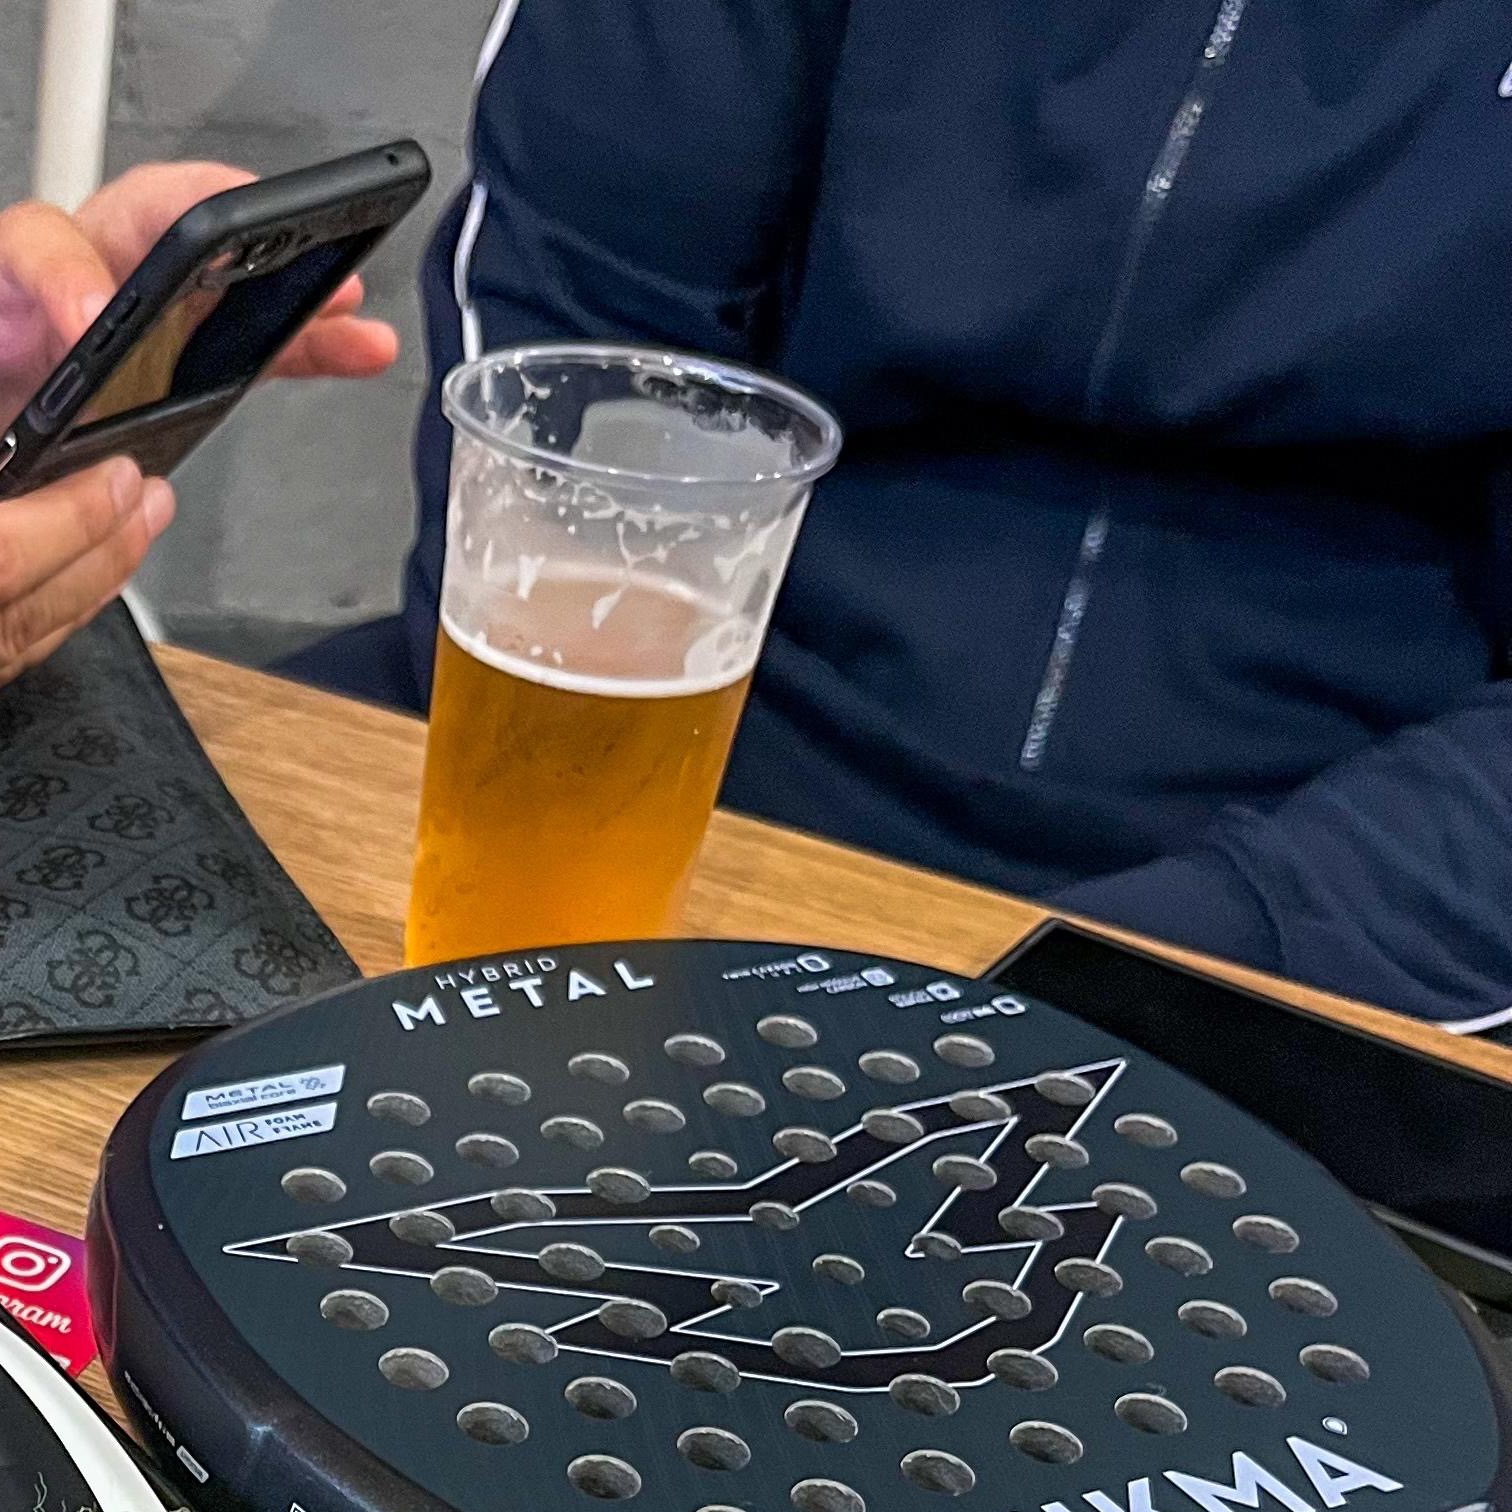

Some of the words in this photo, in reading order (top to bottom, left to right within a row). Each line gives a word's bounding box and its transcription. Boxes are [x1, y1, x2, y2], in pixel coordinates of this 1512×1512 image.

[434, 957, 558, 990] HYBRID
[391, 960, 655, 1032] METAL
[205, 1081, 293, 1102] METAL
[264, 1113, 307, 1126] FOAM
[195, 1121, 264, 1152] AIR
